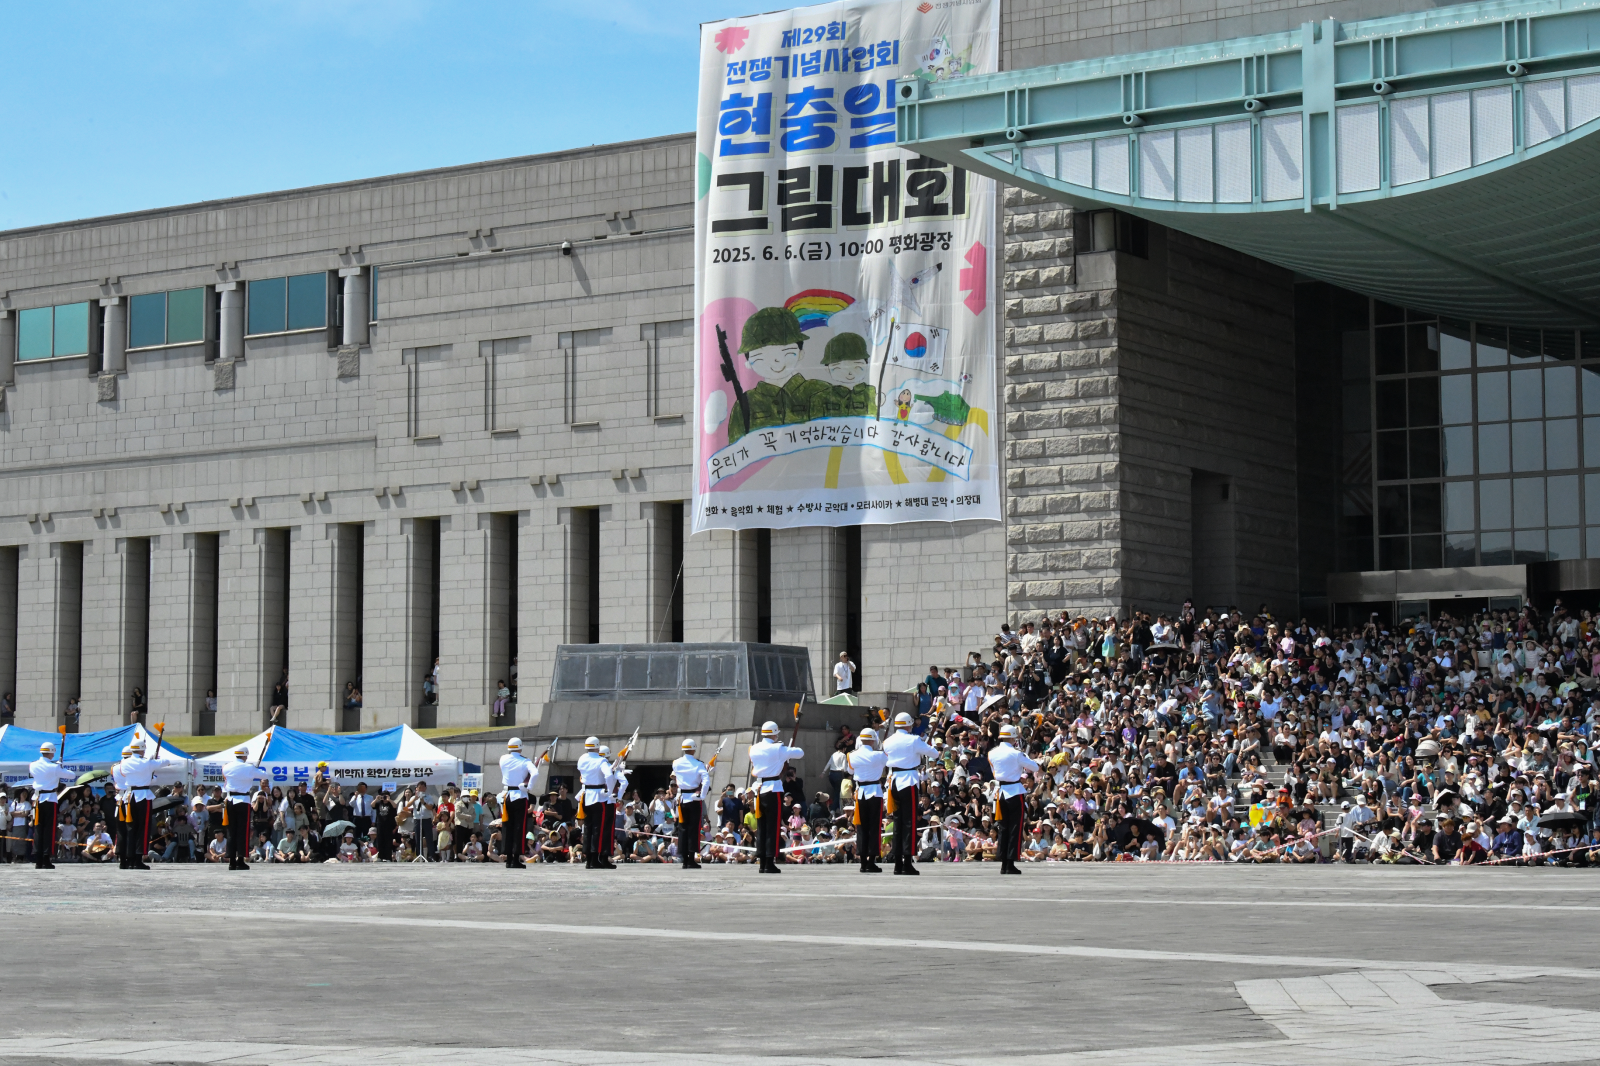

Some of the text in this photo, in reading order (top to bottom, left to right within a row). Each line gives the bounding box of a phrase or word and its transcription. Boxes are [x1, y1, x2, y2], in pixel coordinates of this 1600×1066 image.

[781, 21, 847, 49] 제29회
[726, 39, 900, 86] 전쟁기념사업회
[718, 79, 896, 157] 현충일
[711, 155, 967, 233] 그림대회
[712, 246, 756, 264] 2025.
[839, 239, 884, 257] 10:00
[889, 231, 953, 255] 평화광장
[711, 424, 965, 479] 우리가 꼭 기억하겠습니다 감사합니다
[730, 505, 753, 517] 음악회
[766, 504, 783, 515] 체험
[797, 502, 823, 513] 수방사
[824, 502, 848, 513] 군악대
[856, 499, 893, 511] 모터사이카
[904, 496, 929, 508] 해병대
[931, 496, 948, 507] 군악
[956, 494, 981, 506] 의장대
[334, 767, 433, 779] 예약자 확인/현장 접수
